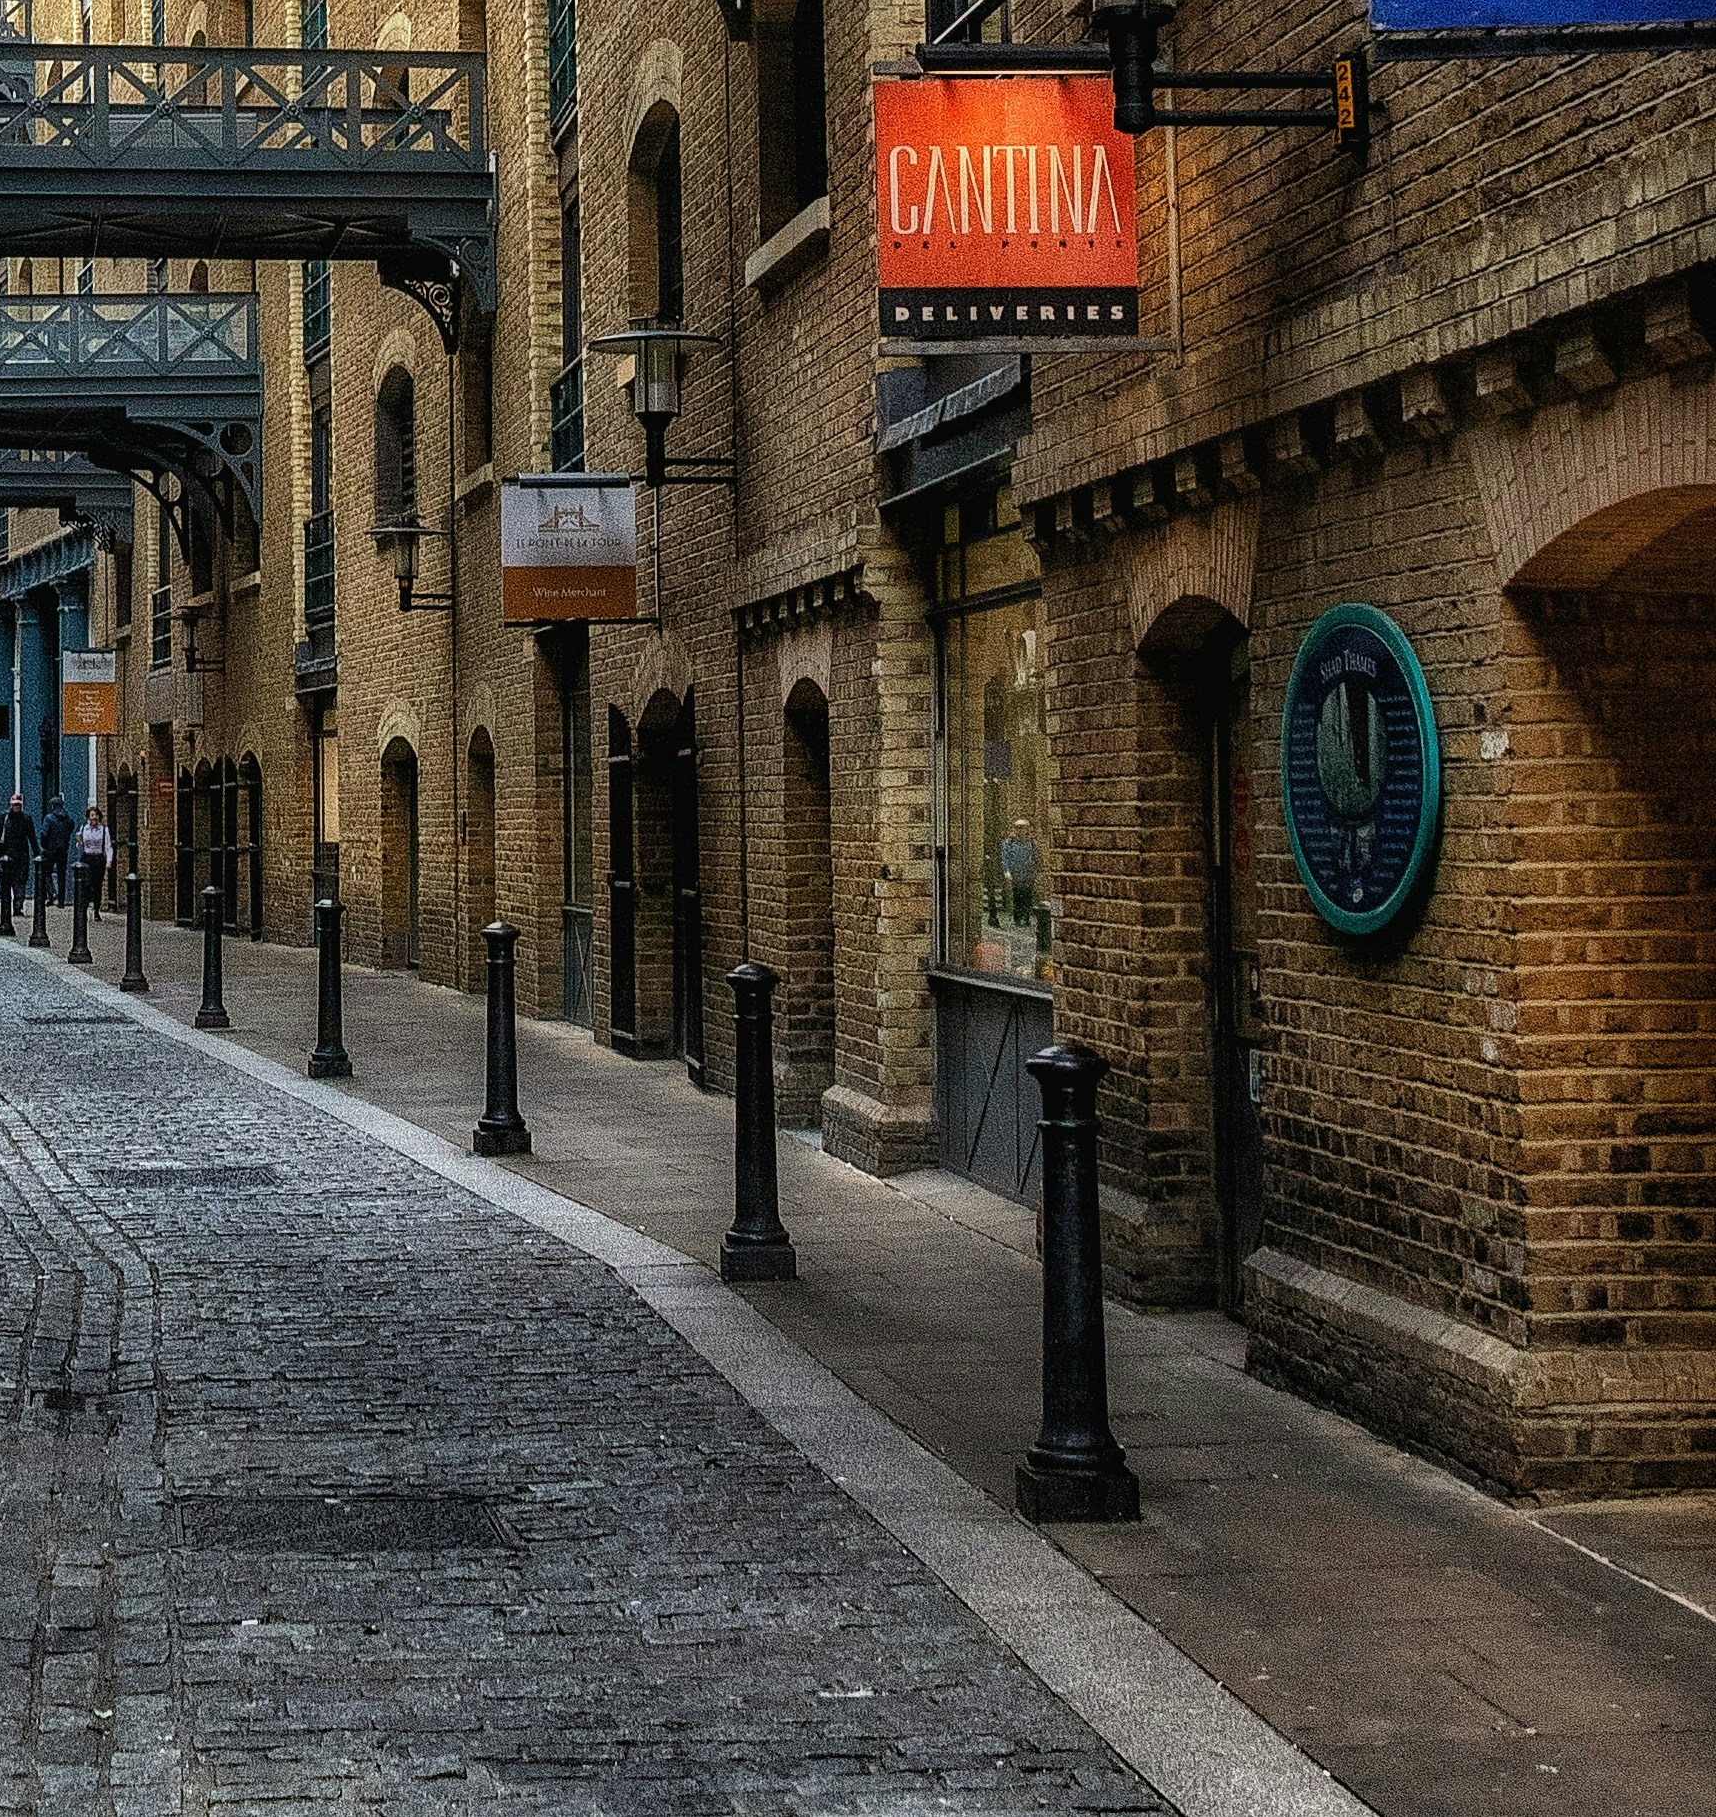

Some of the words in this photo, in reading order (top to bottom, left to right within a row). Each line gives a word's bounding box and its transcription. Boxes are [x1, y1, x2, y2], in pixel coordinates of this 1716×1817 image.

[888, 144, 1122, 236] CANTINA
[894, 305, 1125, 323] DELIVERIES
[561, 586, 606, 597] Merchant
